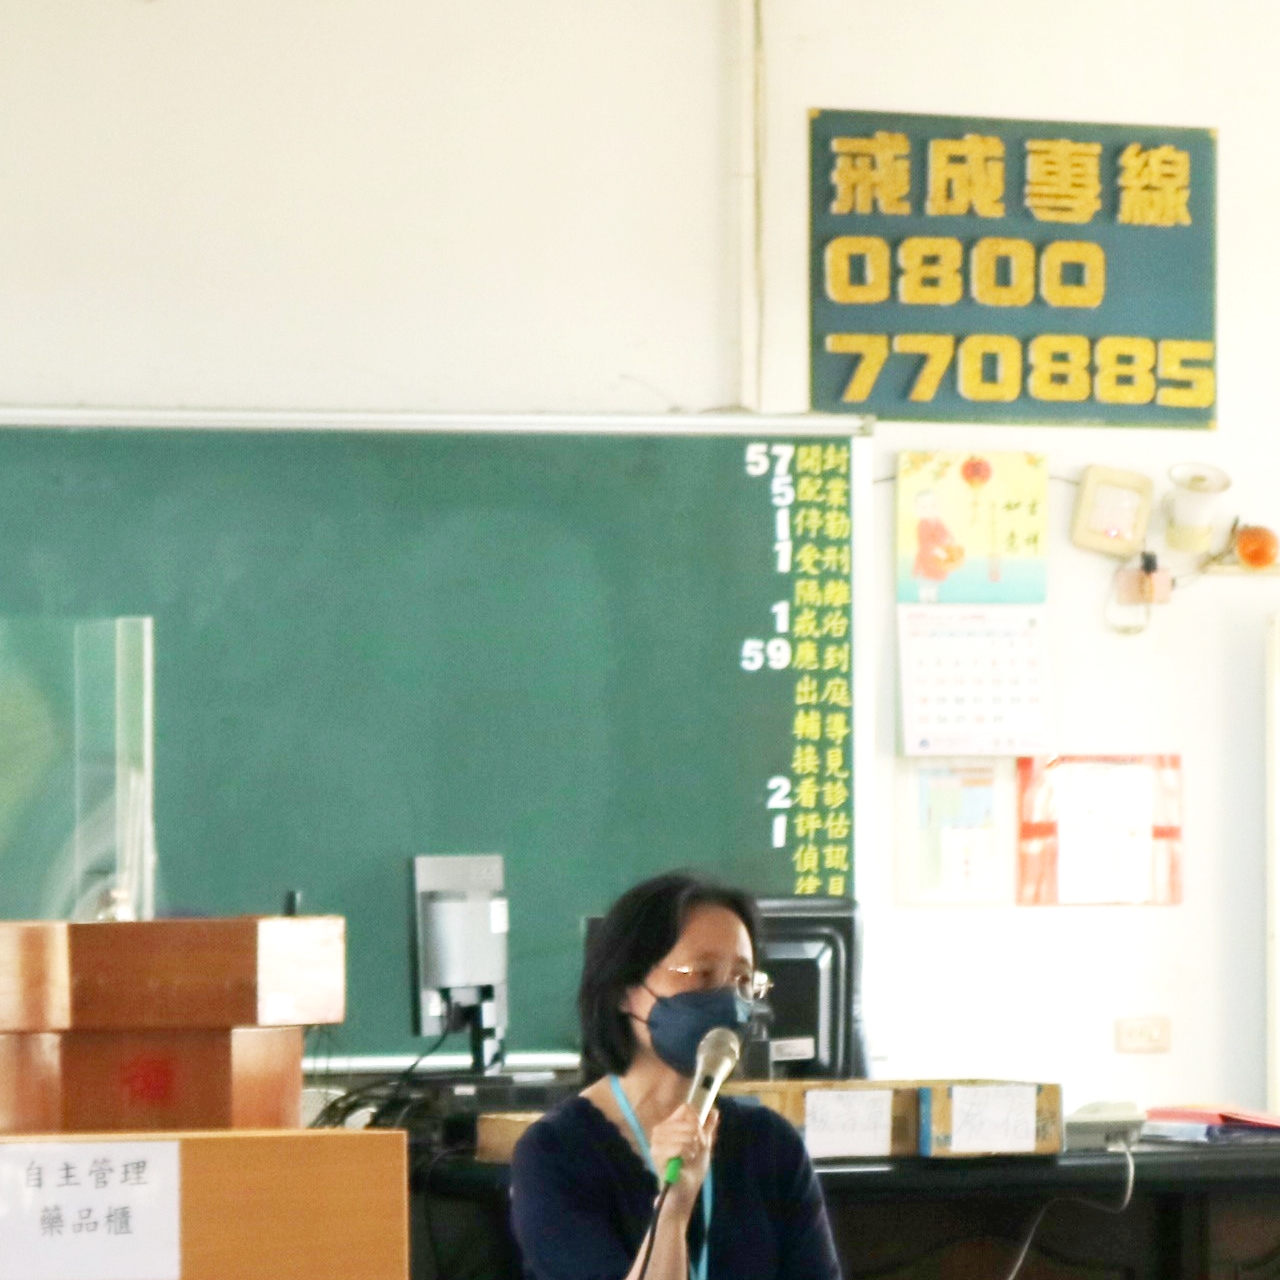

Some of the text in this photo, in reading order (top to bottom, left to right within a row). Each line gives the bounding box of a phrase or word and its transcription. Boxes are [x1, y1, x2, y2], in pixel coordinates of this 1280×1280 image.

[831, 130, 1192, 227] 戒成專線
[826, 235, 1106, 308] 0800
[826, 334, 1214, 408] 770885
[745, 443, 795, 476] 57
[772, 475, 795, 507] 5
[774, 540, 793, 573] 1
[772, 600, 790, 633] 1
[740, 638, 792, 671] 59
[794, 674, 852, 707] 出庭
[791, 744, 849, 778] 接見
[766, 776, 792, 809] 2
[793, 812, 850, 841] 評估
[24, 1158, 150, 1190] 自主管理
[39, 1204, 135, 1238] 藥品櫃
